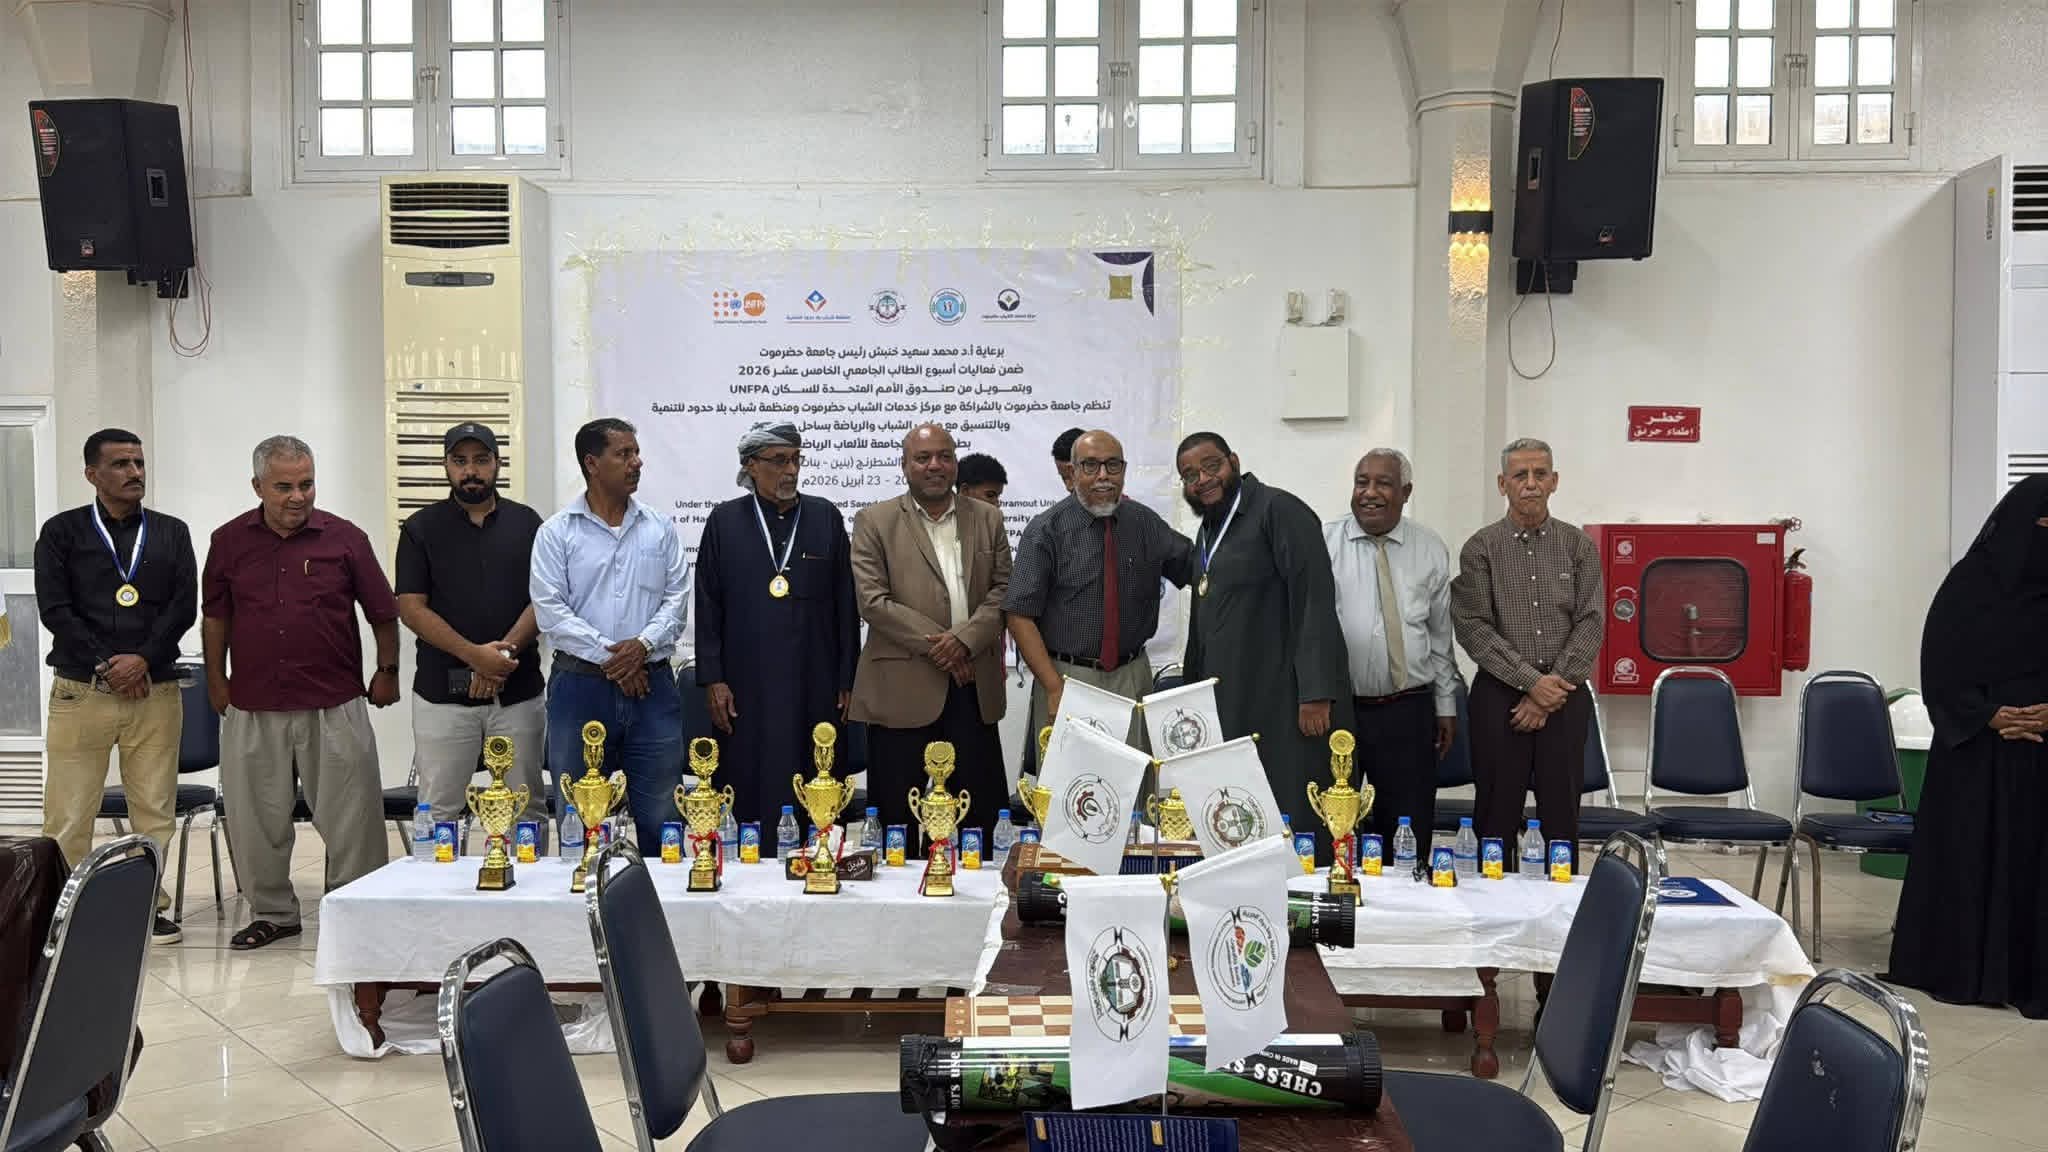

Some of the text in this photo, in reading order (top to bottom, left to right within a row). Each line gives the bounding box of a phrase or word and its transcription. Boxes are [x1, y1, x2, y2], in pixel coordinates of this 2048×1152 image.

[760, 347, 804, 359] حضرموت
[805, 346, 836, 360] جامعة
[838, 346, 866, 359] رئيس
[868, 346, 899, 359] خنبش
[901, 345, 930, 359] سعيد
[932, 345, 959, 358] محمد
[975, 345, 1005, 358] برعاية
[738, 363, 1024, 380] ضمن فعاليات أسبوع الطالب الجامعي الخامس عشر 2026
[730, 383, 1032, 397] وبتمويل من صندوق الأمم المتحدة للسكان UNFPA
[651, 400, 1111, 416] تنظم جامعة حضرموت بالشراكة مع مركز خدمات الشباب حضرموت ومنظمة شباب بلا حدود للتنمية
[1644, 411, 1687, 425] خطر
[798, 420, 831, 435] بساحل
[833, 421, 876, 436] والرياضة
[877, 420, 912, 435] الشباب
[944, 422, 958, 434] مع
[960, 419, 1010, 432] وبالتنسيق
[1633, 425, 1663, 437] حريق
[801, 438, 903, 451] لجامعة للألعاب الرياض
[858, 457, 901, 472] الشطرنج
[841, 473, 864, 488] أبريل
[867, 475, 880, 486] 23
[675, 500, 703, 508] Under
[998, 499, 1037, 507] hramout
[679, 515, 690, 523] of
[1004, 514, 1031, 523] ersity
[1253, 1063, 1322, 1096] CHESS
